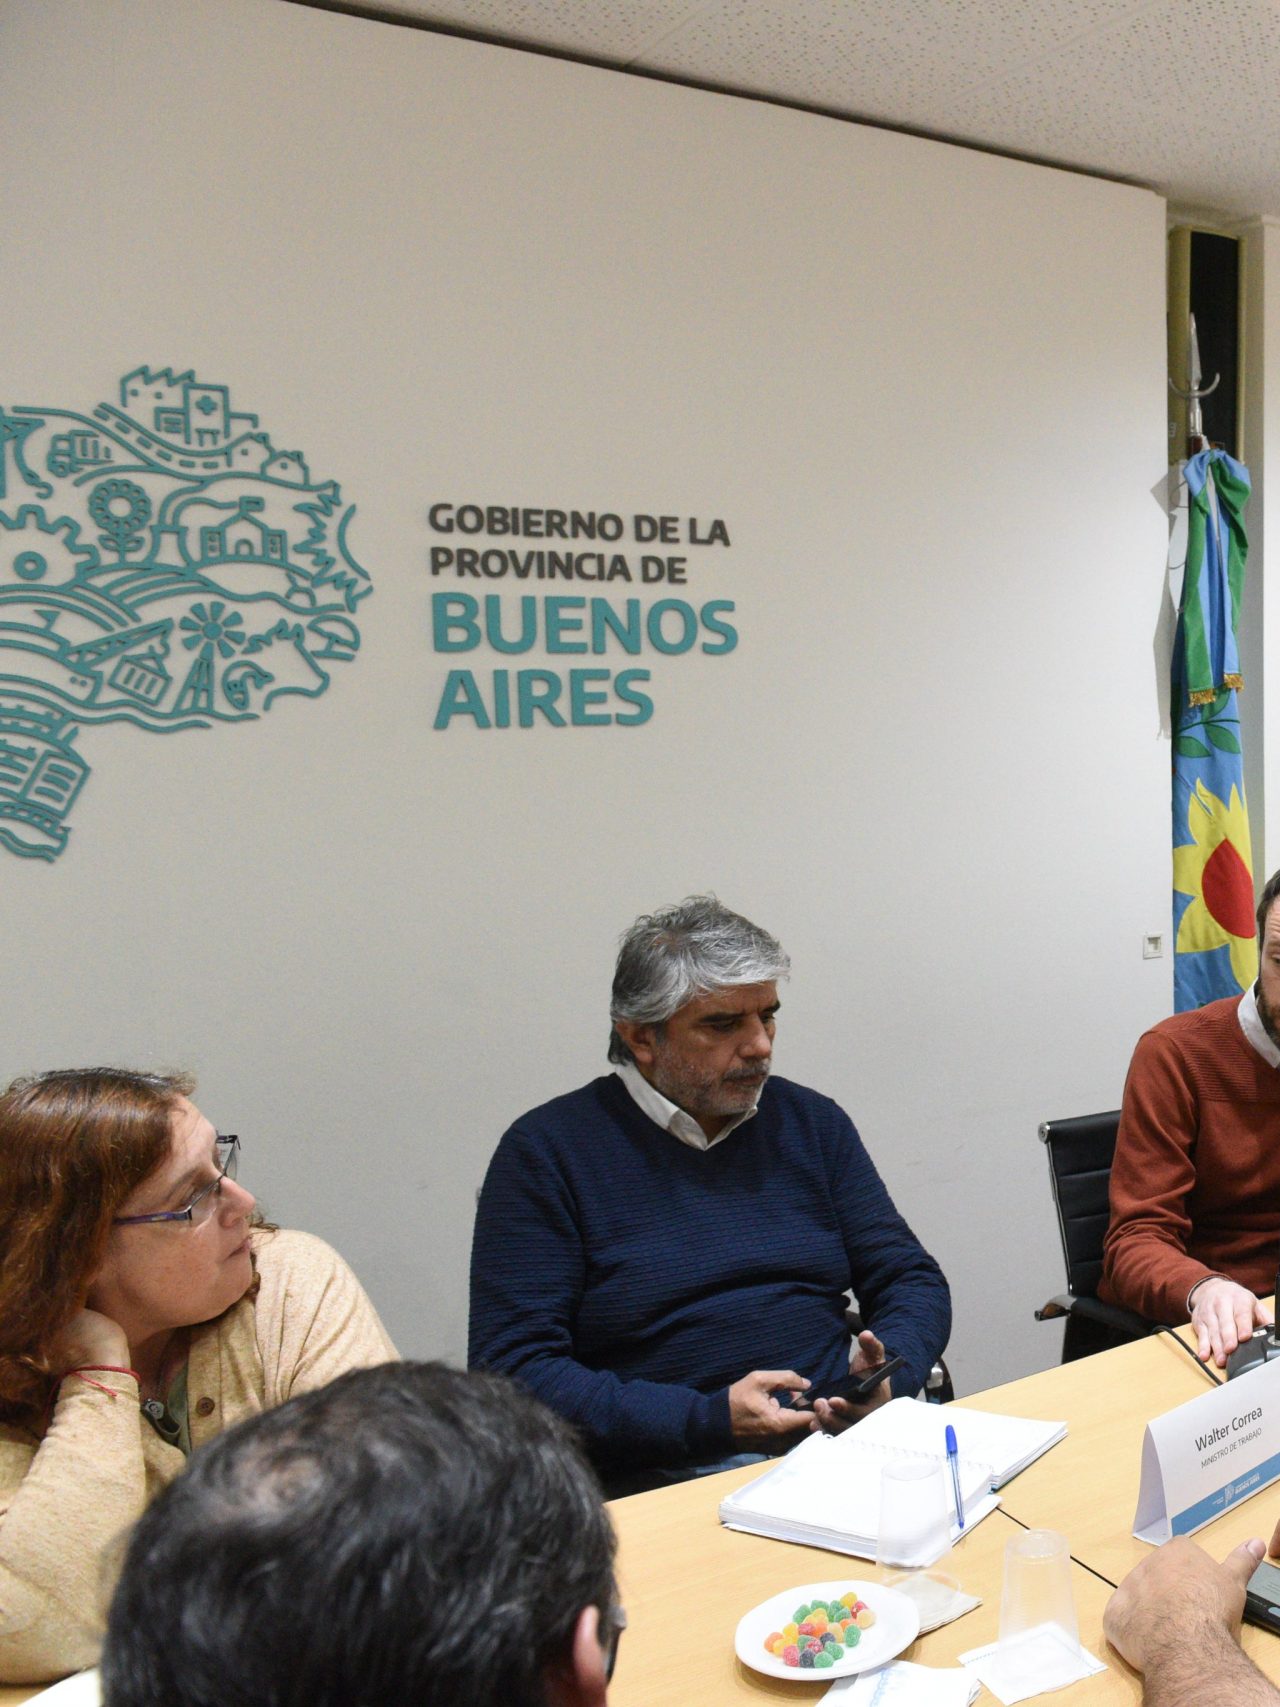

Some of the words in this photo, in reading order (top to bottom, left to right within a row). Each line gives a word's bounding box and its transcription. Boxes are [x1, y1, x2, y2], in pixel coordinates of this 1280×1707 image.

[428, 503, 624, 541] GOBIERNO
[634, 514, 681, 543] DE
[689, 517, 731, 547] LA
[430, 546, 632, 582] PROVINCIA
[641, 555, 688, 584] DE
[431, 592, 739, 656] BUENOS
[433, 668, 655, 730] AIRES
[1195, 1424, 1230, 1452] Walter
[1231, 1407, 1263, 1432] Correa
[1201, 1446, 1229, 1469] MINISTRO
[1229, 1441, 1238, 1453] DE
[1237, 1428, 1262, 1447] TRABAJO
